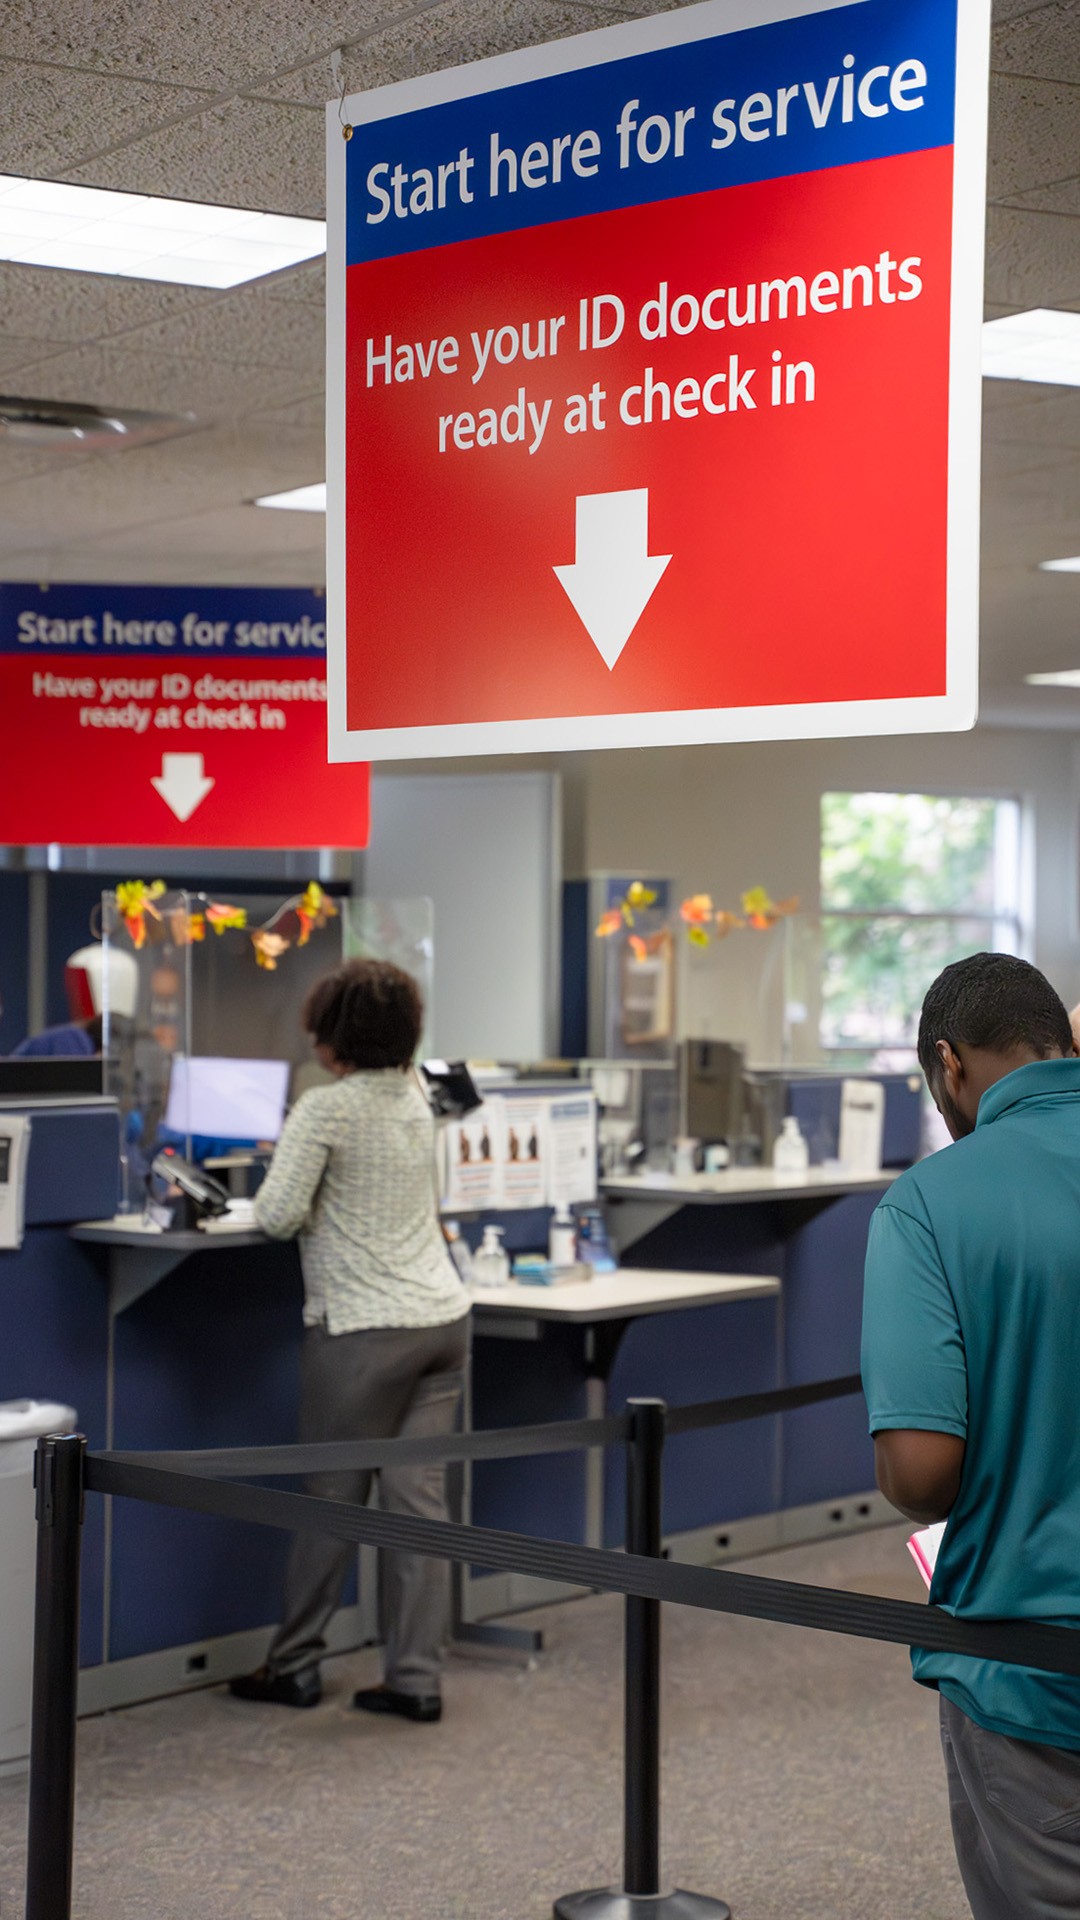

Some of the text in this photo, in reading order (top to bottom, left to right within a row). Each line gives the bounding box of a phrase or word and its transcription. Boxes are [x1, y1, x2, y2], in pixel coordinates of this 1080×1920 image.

[367, 55, 927, 224] Start here for service
[366, 251, 922, 388] Have your ID documents
[437, 350, 814, 455] ready at check in
[18, 612, 326, 648] Start here for servic
[33, 672, 93, 698] Have
[99, 675, 157, 704] your
[162, 674, 191, 699] ID
[80, 703, 286, 733] ready at check in
